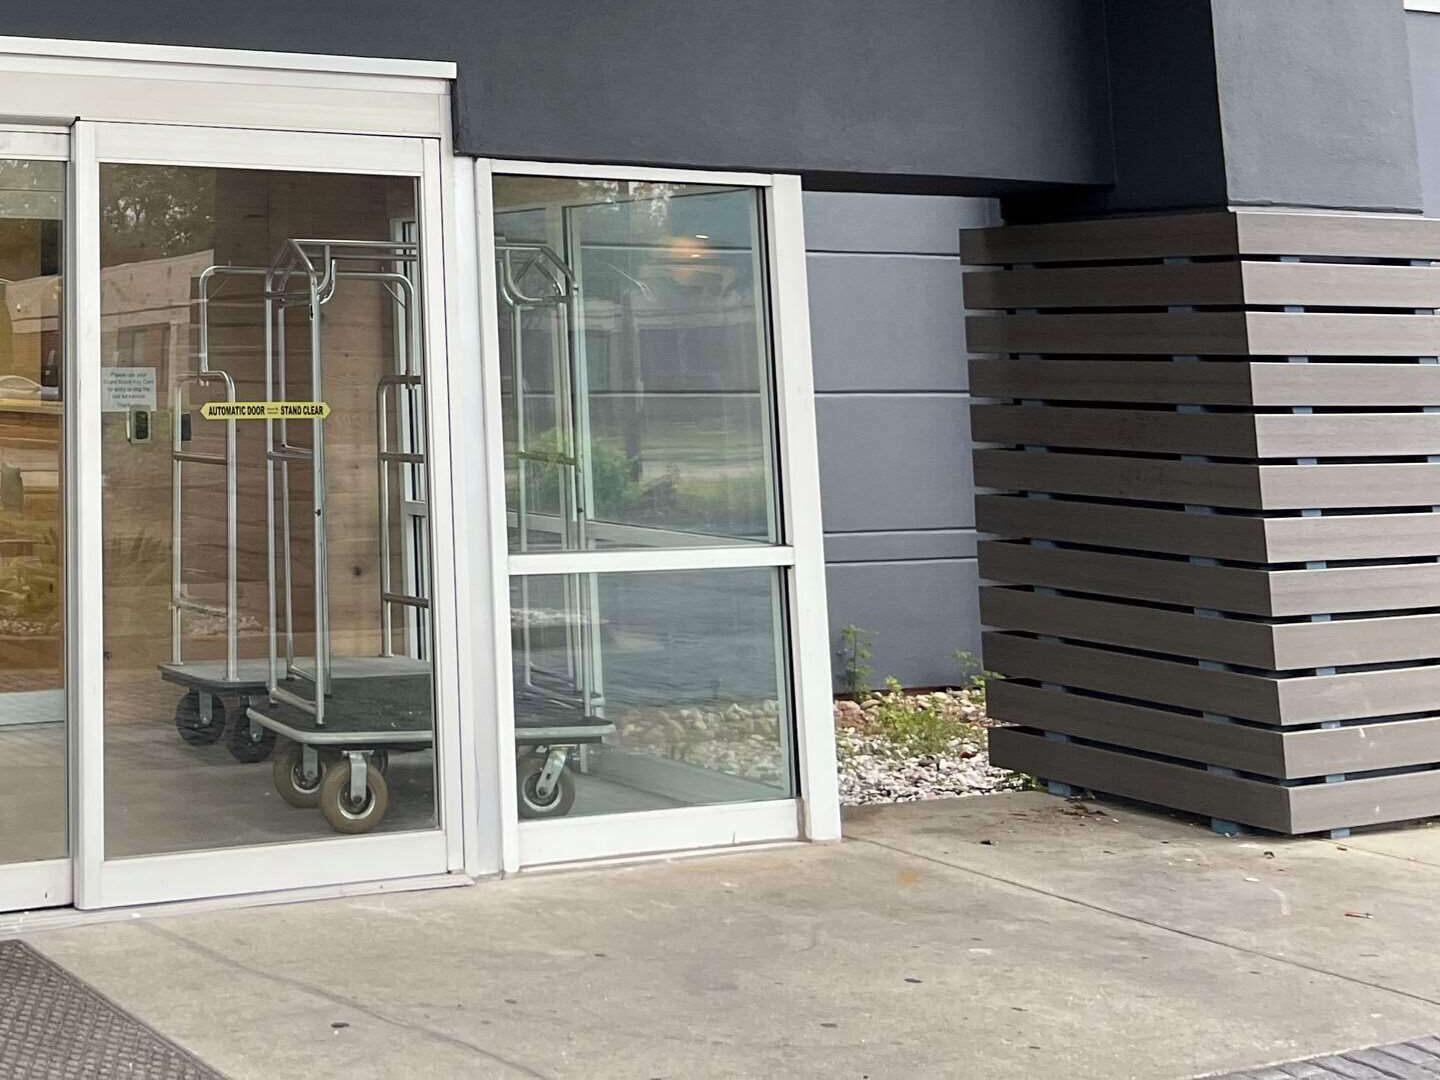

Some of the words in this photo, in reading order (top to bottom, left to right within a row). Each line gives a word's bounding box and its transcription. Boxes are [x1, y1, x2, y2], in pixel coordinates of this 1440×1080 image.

[208, 406, 246, 415] AUTOMATIC
[248, 406, 265, 415] DOOR
[280, 406, 301, 415] STAND
[304, 406, 323, 415] CLEAR
